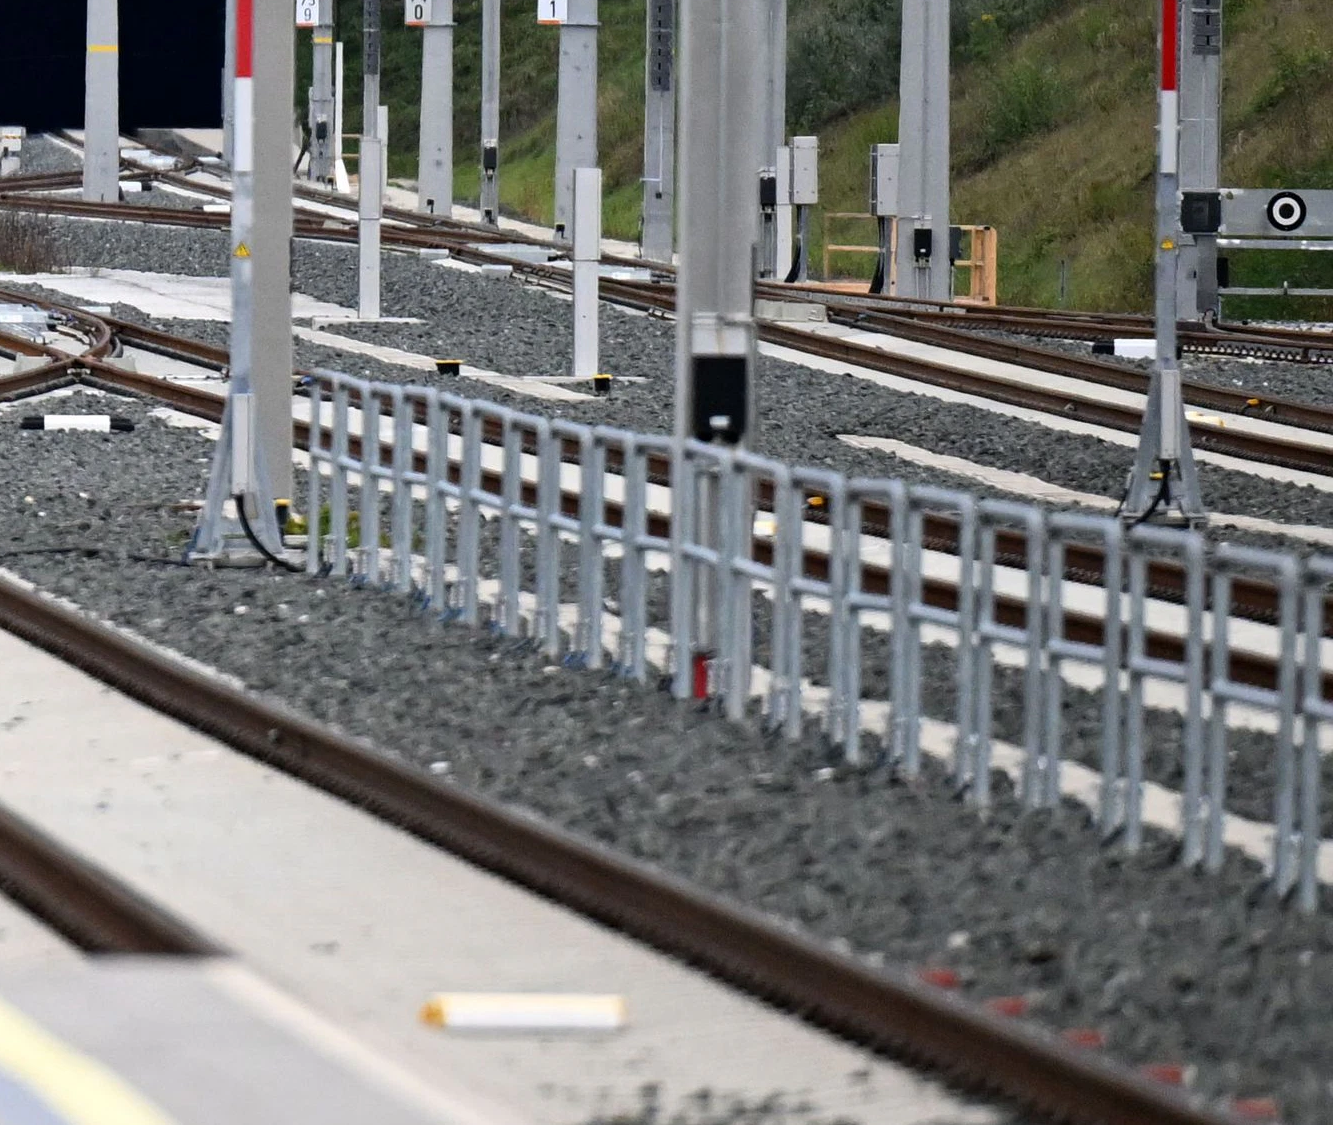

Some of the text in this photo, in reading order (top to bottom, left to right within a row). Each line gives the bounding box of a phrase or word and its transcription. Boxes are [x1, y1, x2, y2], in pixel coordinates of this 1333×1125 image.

[304, 8, 311, 21] 9
[414, 4, 423, 20] 0
[550, 0, 555, 18] 1
